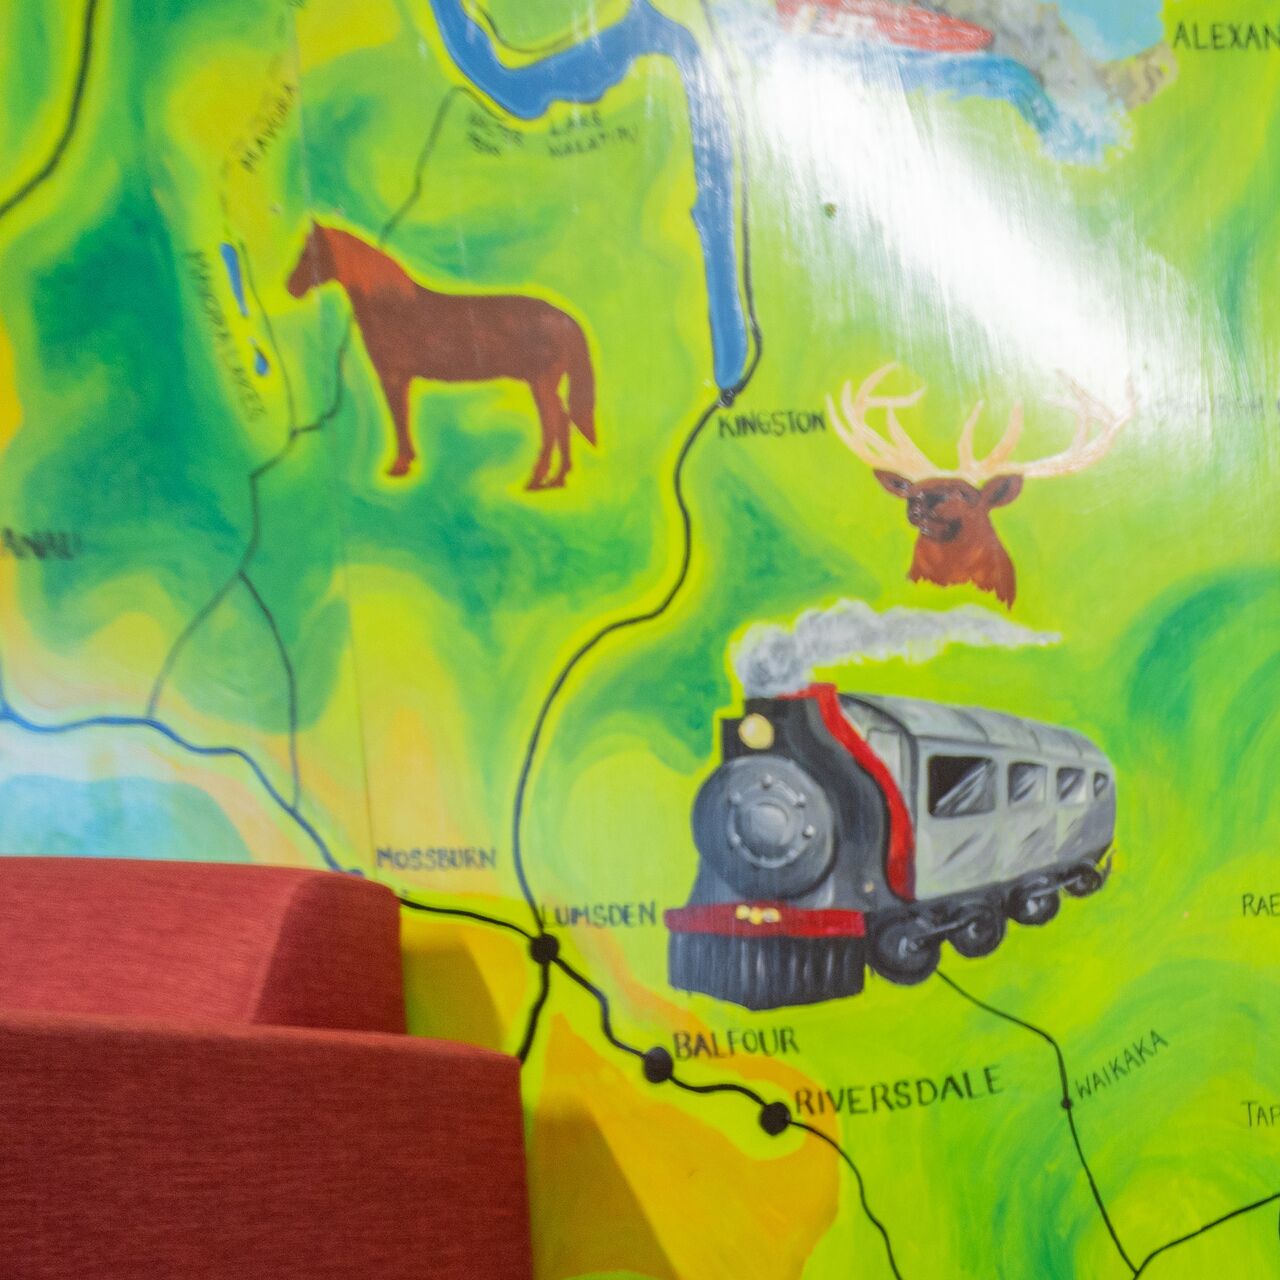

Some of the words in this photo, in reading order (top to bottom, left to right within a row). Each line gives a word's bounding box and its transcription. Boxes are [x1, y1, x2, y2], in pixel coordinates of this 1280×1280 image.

[718, 409, 827, 439] KINGSTON
[375, 846, 497, 872] MOSSBURN
[537, 900, 657, 928] LUMSDEN
[674, 1026, 800, 1060] BALFOUR
[1075, 1029, 1169, 1101] WAIKAKA
[794, 1065, 1006, 1117] RIVERSDALE
